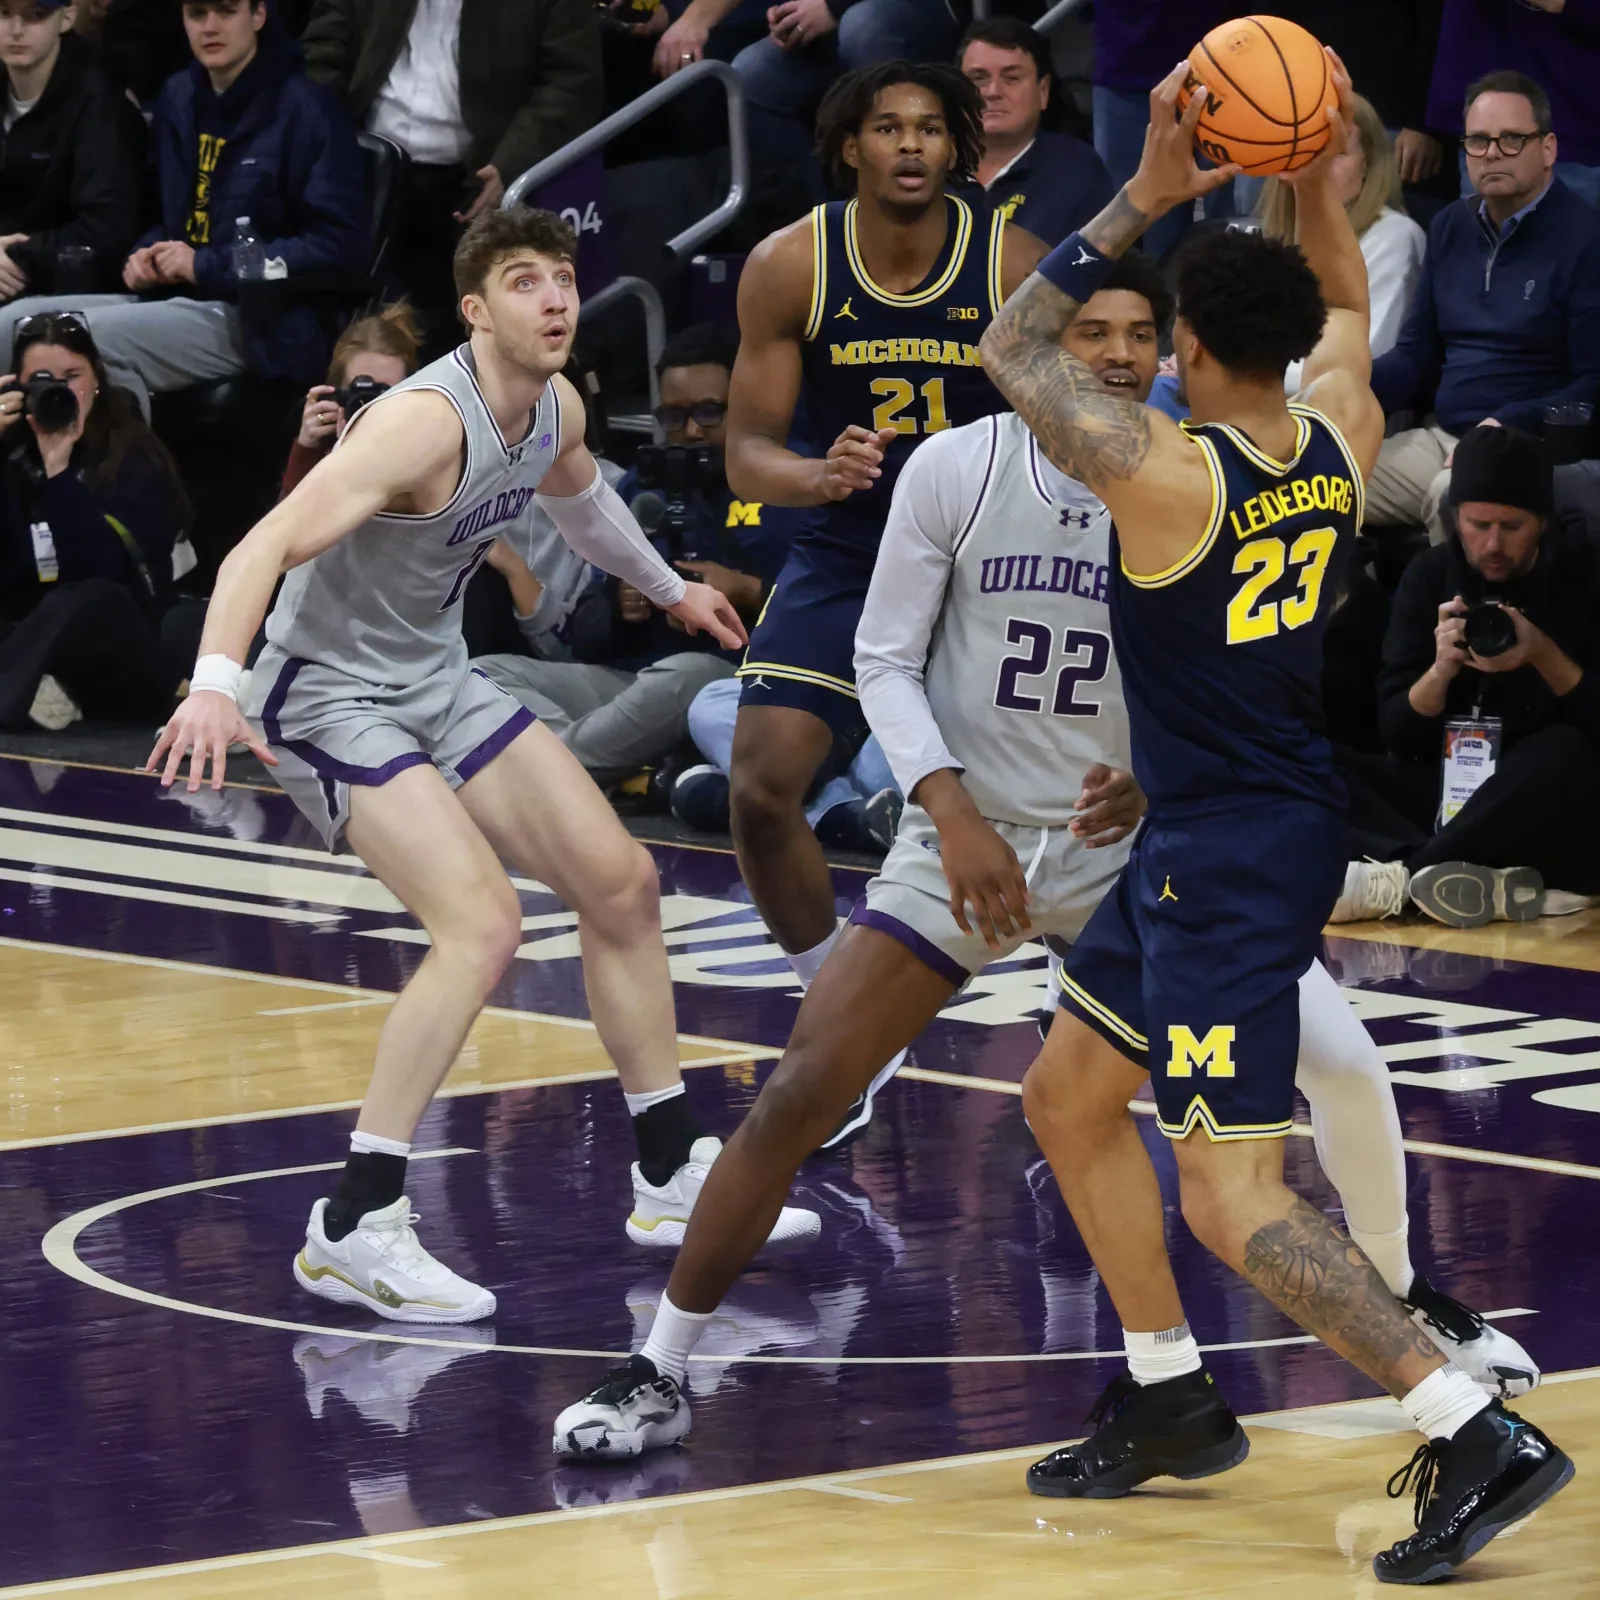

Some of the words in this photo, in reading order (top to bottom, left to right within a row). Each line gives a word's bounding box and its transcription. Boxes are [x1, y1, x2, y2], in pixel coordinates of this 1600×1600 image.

[829, 338, 983, 366] MICHIGAN
[870, 378, 952, 434] 21
[725, 500, 763, 528] M
[1229, 474, 1353, 540] LEDEBORG
[1226, 526, 1337, 645] 23
[993, 616, 1112, 718] 22
[1167, 1025, 1236, 1077] M
